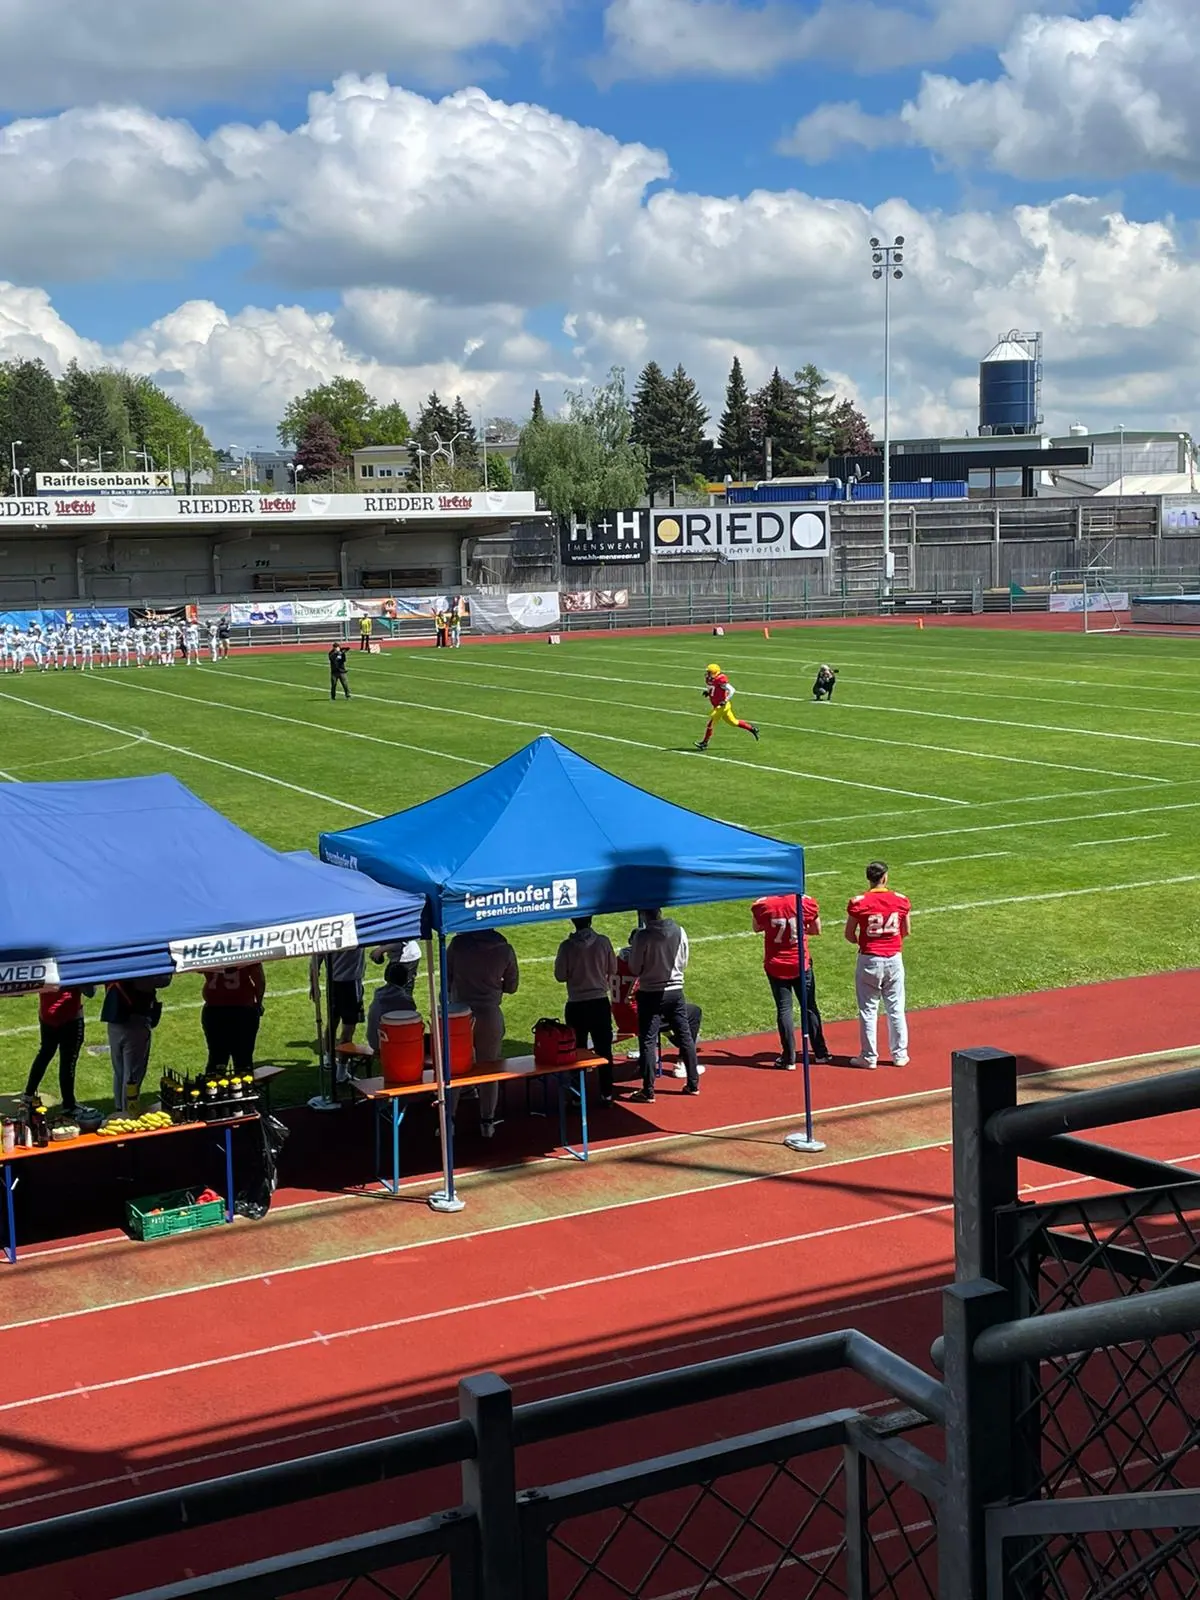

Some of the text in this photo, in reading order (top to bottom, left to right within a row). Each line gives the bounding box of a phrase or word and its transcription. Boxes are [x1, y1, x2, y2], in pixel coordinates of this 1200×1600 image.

[43, 475, 150, 486] Raiffeisenbank
[177, 499, 254, 513] RIEDER
[364, 497, 434, 511] RIEDER
[686, 512, 784, 546] RIED
[465, 885, 551, 908] bernhofer
[476, 902, 551, 920] gesenkschmiede
[866, 912, 901, 937] 24
